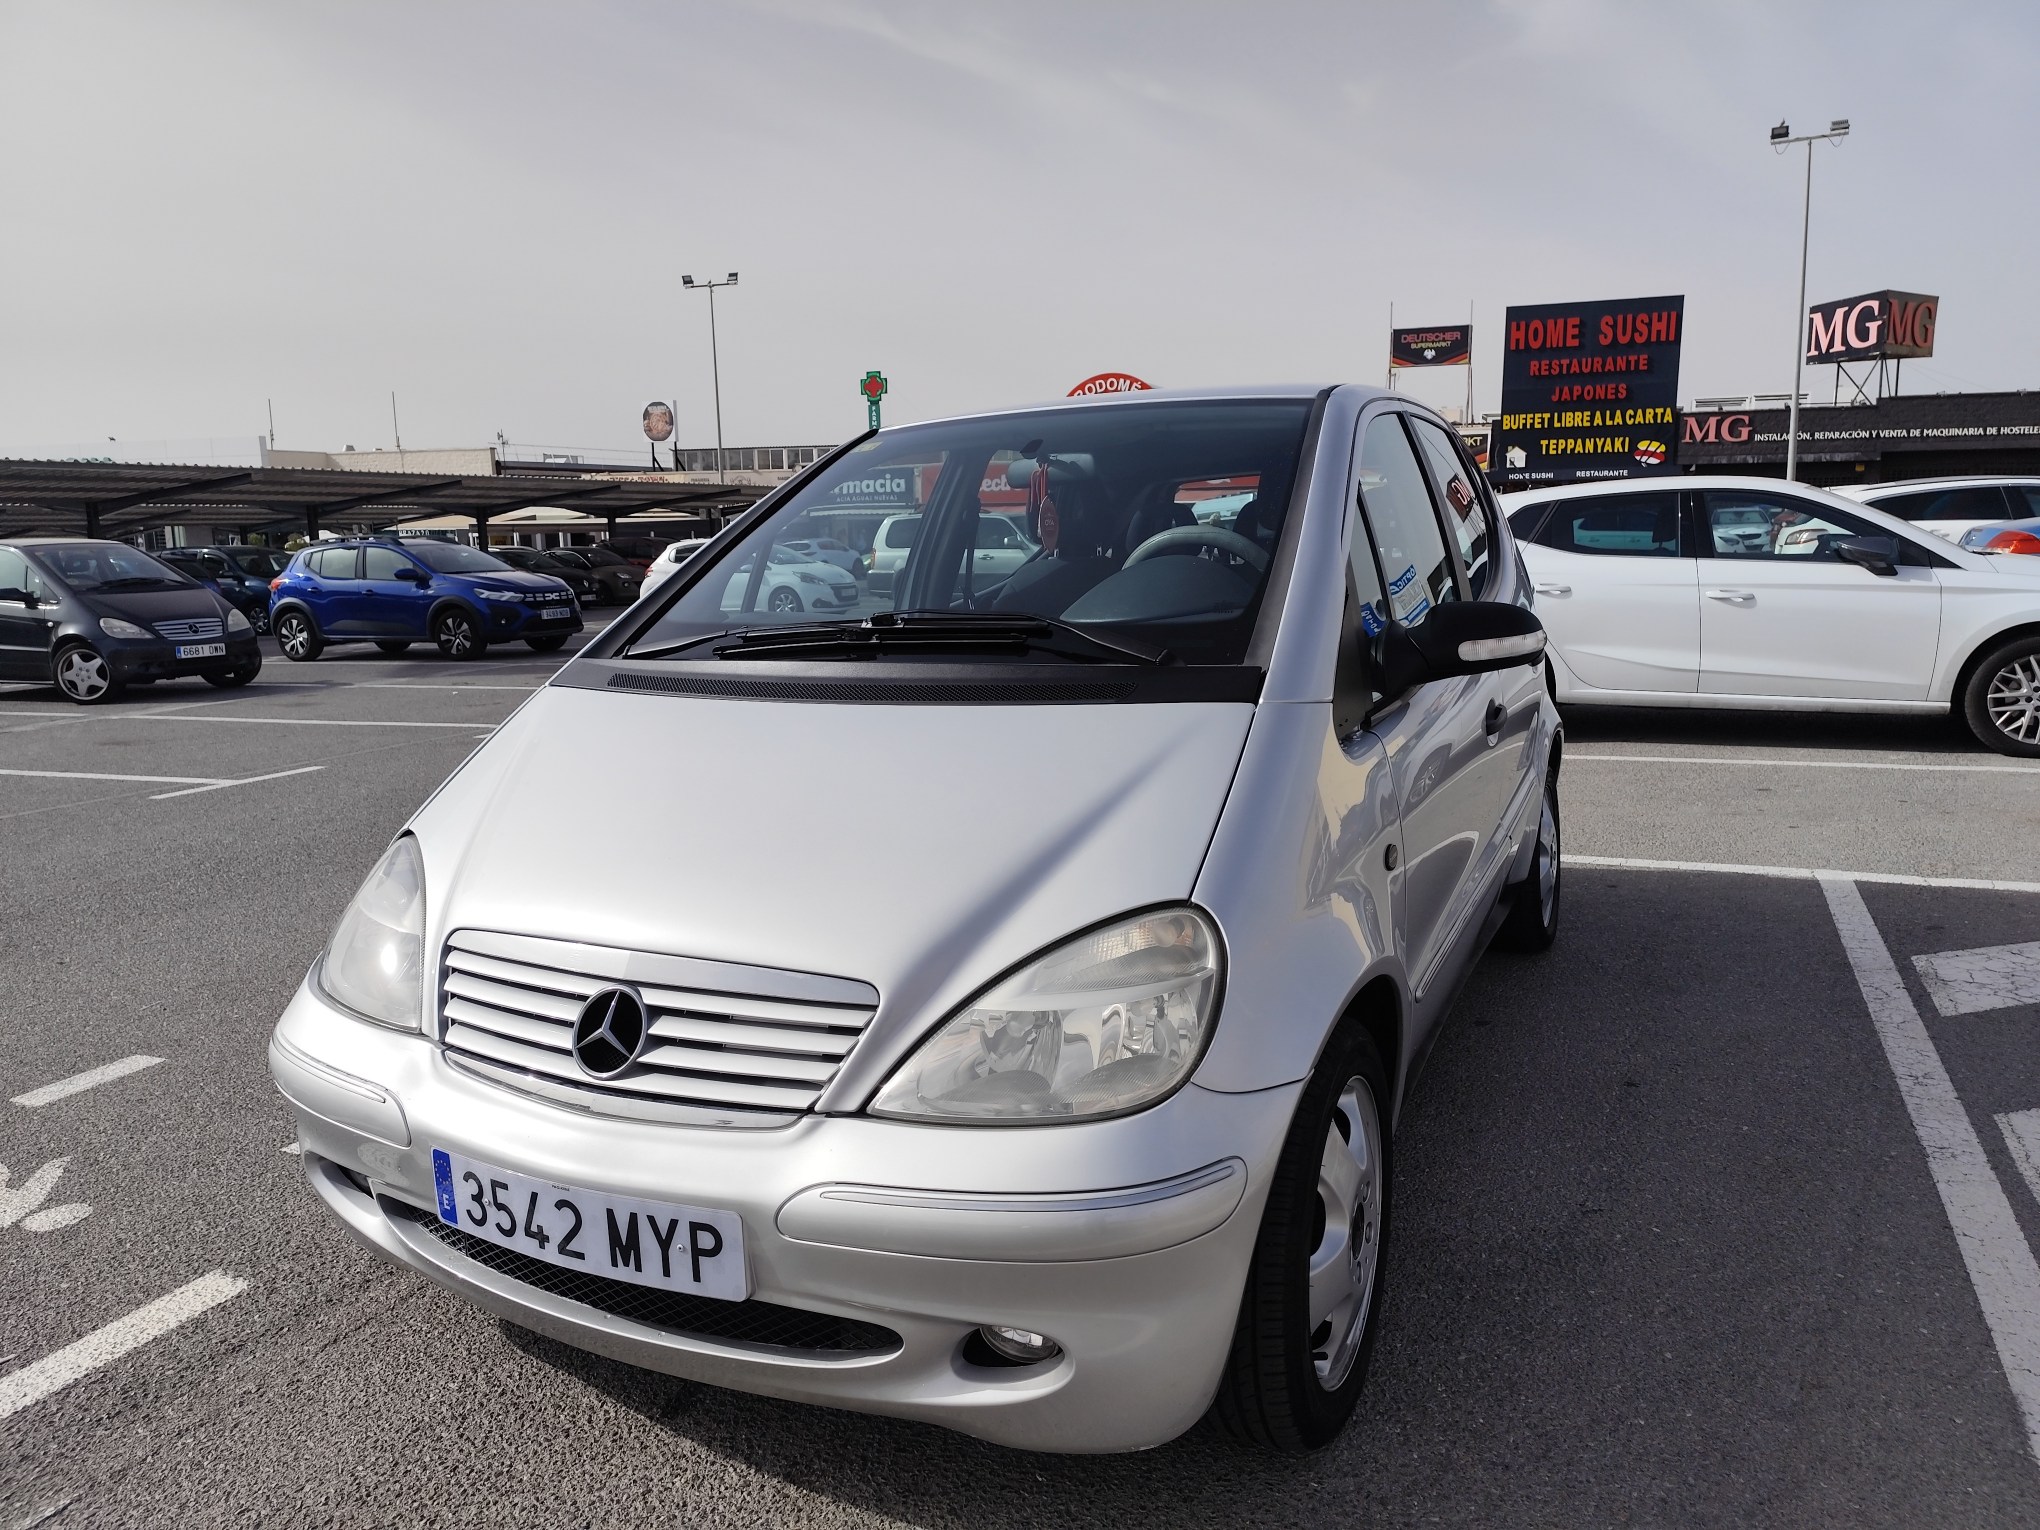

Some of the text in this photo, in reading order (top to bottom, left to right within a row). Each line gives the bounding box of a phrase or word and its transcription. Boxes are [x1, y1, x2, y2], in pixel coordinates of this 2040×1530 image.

[1510, 311, 1677, 350] HOME SUSHI
[1807, 300, 1882, 356] MG
[1886, 298, 1937, 348] MG
[1401, 331, 1461, 343] DEUTSCHER
[1411, 341, 1451, 349] SUPERMARKT
[1530, 354, 1648, 376] RESTAURANTE
[1551, 383, 1627, 402] JAPONES
[1502, 407, 1673, 430] BUFFET LIBRE A LA CARTA
[1681, 415, 1753, 443] MG
[1814, 428, 1870, 440] REPARACIÓN
[1872, 429, 1879, 438] Y
[1879, 429, 1908, 438] VENTA
[1909, 428, 1921, 437] DE
[1923, 427, 1984, 437] MAQUINARIA
[1986, 427, 1998, 435] DE
[1540, 437, 1630, 455] TEPPANYAKI
[1531, 472, 1554, 480] SUSHI
[1576, 469, 1628, 478] RESTAURANTE
[183, 646, 205, 656] 6681
[443, 1194, 450, 1210] E
[463, 1171, 723, 1283] 3542 MYP
